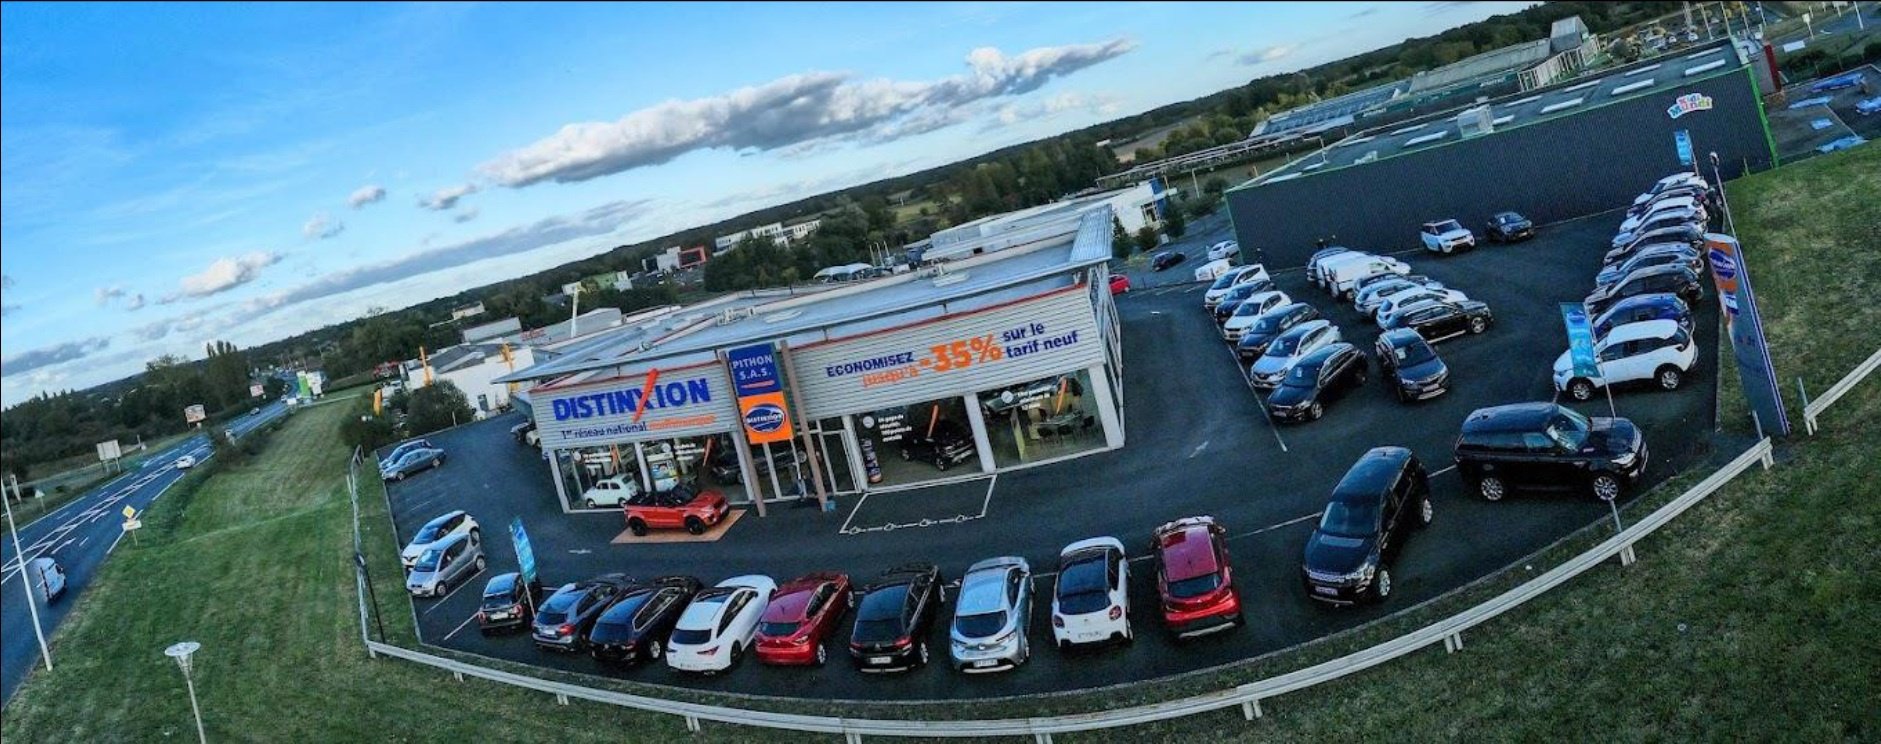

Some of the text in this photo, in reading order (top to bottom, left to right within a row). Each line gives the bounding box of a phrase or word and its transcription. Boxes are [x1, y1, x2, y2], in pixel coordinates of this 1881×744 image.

[1003, 322, 1045, 342] sur le
[919, 334, 1004, 373] -35%
[1006, 331, 1079, 358] tarif neuf
[733, 354, 773, 369] PITHON
[826, 352, 914, 377] ECONOMISEZ
[740, 367, 772, 380] S.A.S.
[553, 368, 711, 421] DISTINXION
[606, 421, 647, 436] national
